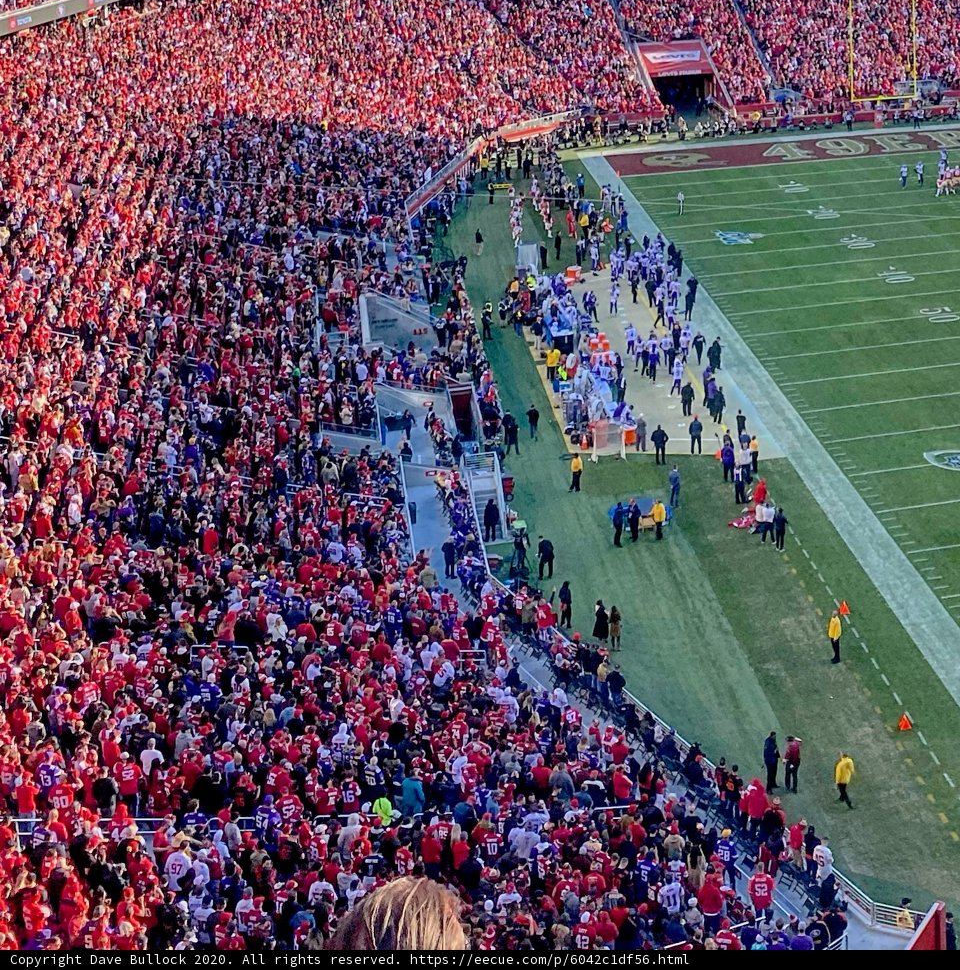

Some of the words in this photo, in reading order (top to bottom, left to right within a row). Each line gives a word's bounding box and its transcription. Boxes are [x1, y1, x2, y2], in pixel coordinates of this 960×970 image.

[919, 306, 960, 324] 50
[40, 771, 51, 786] 13
[52, 795, 69, 809] 80
[342, 790, 355, 804] 16
[255, 817, 269, 832] 54
[487, 843, 498, 856] 10
[718, 849, 729, 862] 28
[171, 863, 183, 876] 97
[755, 883, 768, 897] 52
[666, 893, 678, 907] 11
[575, 935, 588, 949] 42
